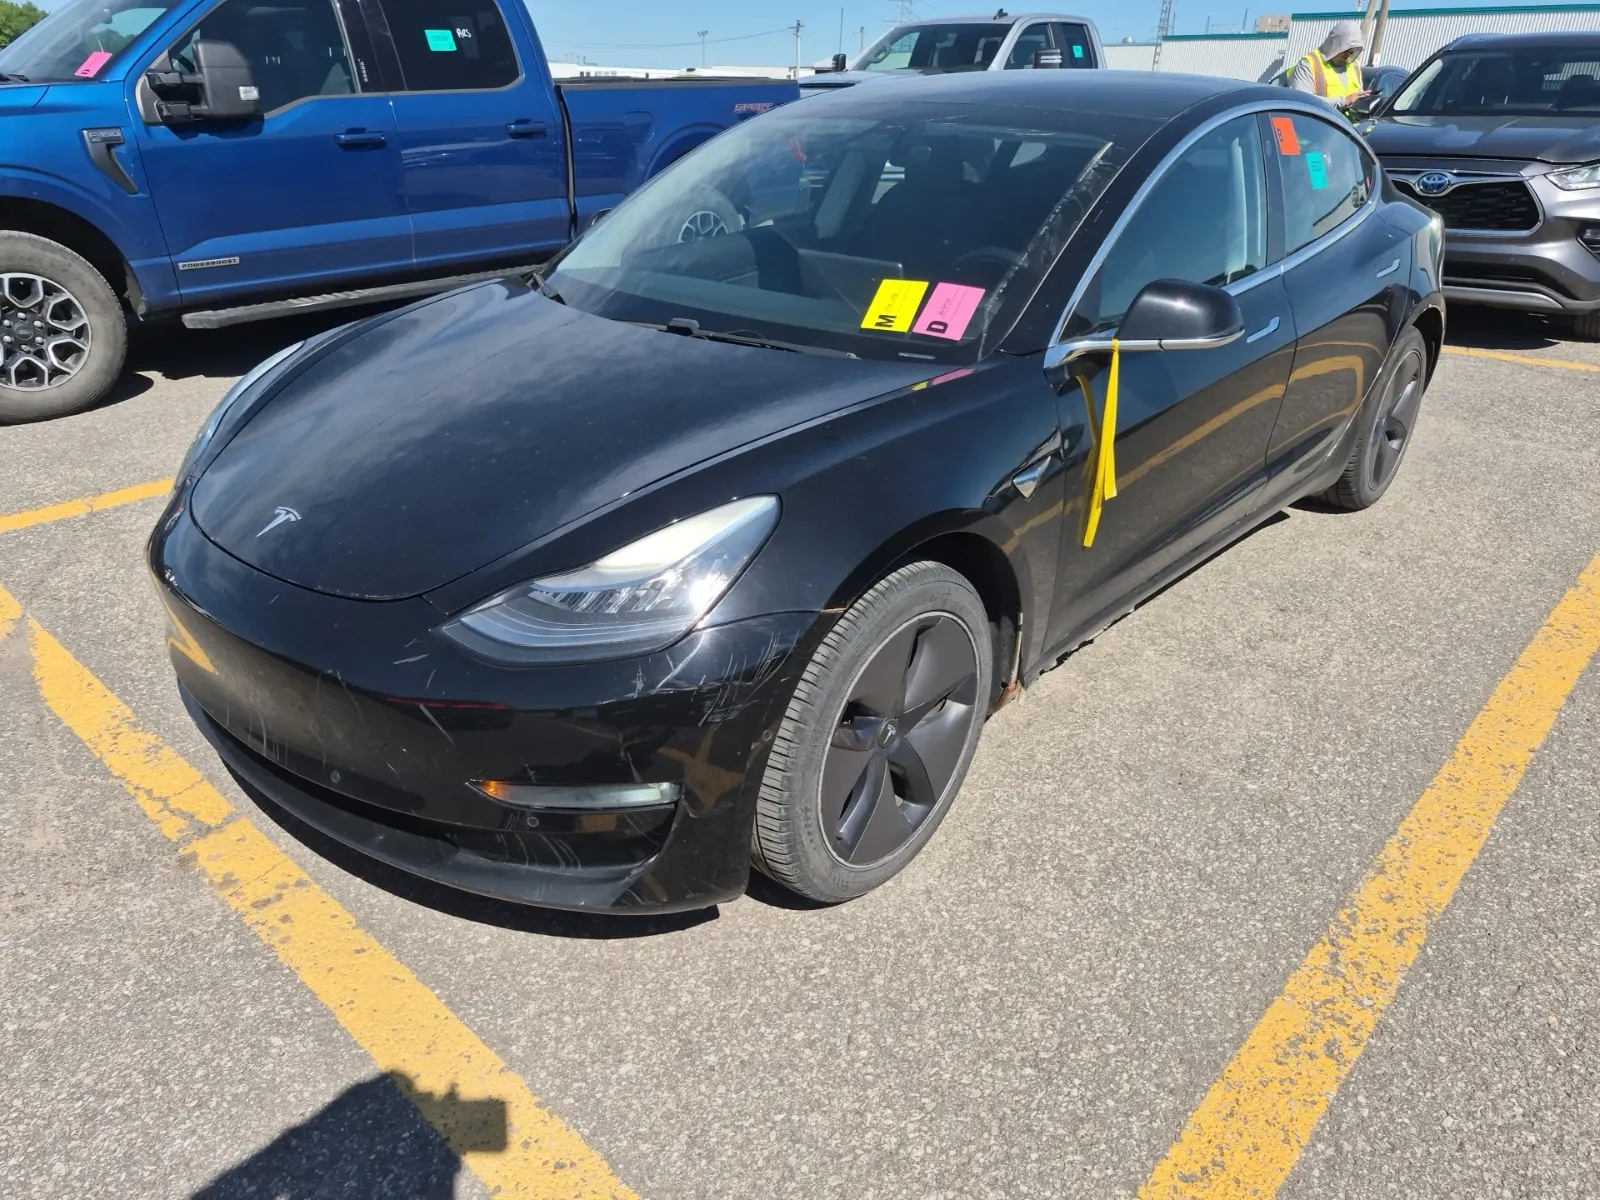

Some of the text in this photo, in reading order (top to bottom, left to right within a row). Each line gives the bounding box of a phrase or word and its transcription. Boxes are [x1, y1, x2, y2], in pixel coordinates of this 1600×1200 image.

[182, 259, 237, 268] POWERBOOST
[875, 314, 897, 328] M
[926, 321, 948, 334] D
